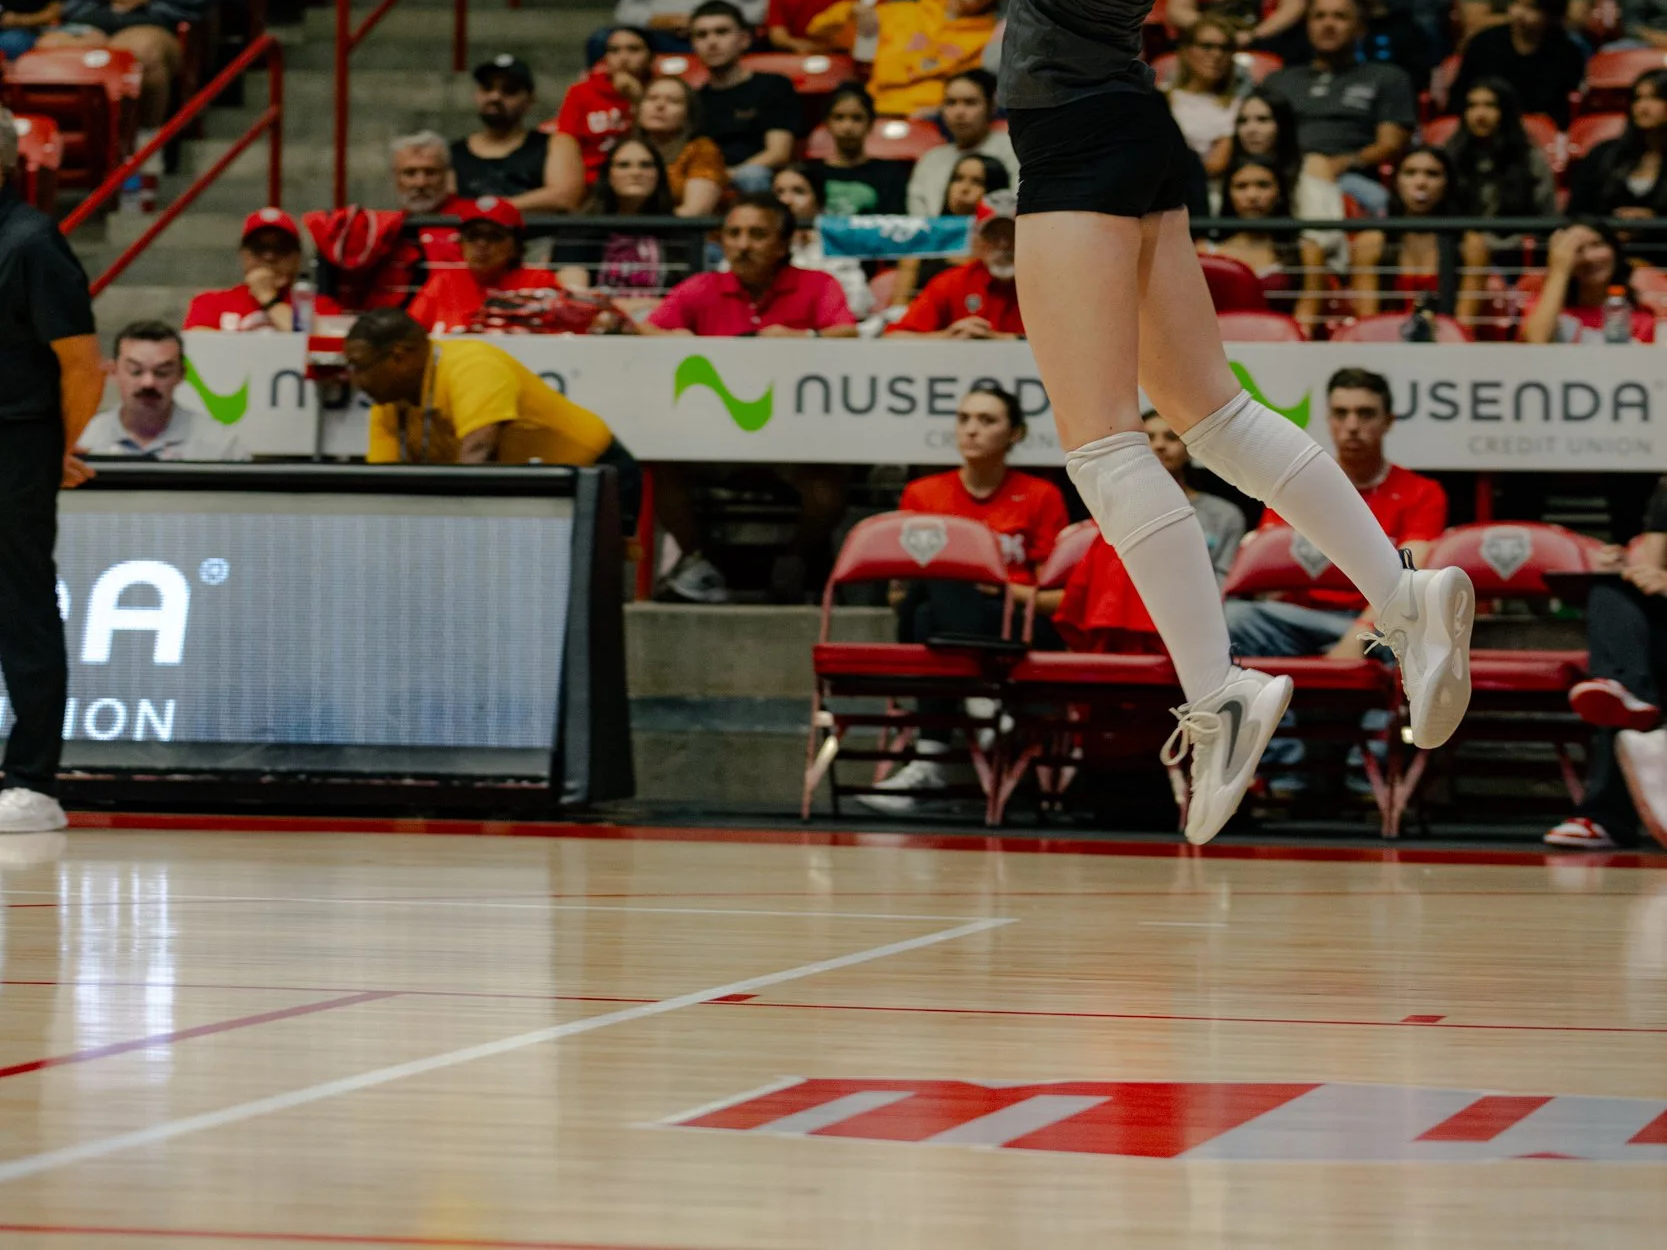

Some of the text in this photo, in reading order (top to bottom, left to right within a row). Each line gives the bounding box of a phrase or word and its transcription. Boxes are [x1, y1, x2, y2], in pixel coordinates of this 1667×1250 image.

[796, 373, 1050, 416] NUSED
[1393, 380, 1650, 422] USENDA
[1467, 436, 1653, 454] CREDIT UNION
